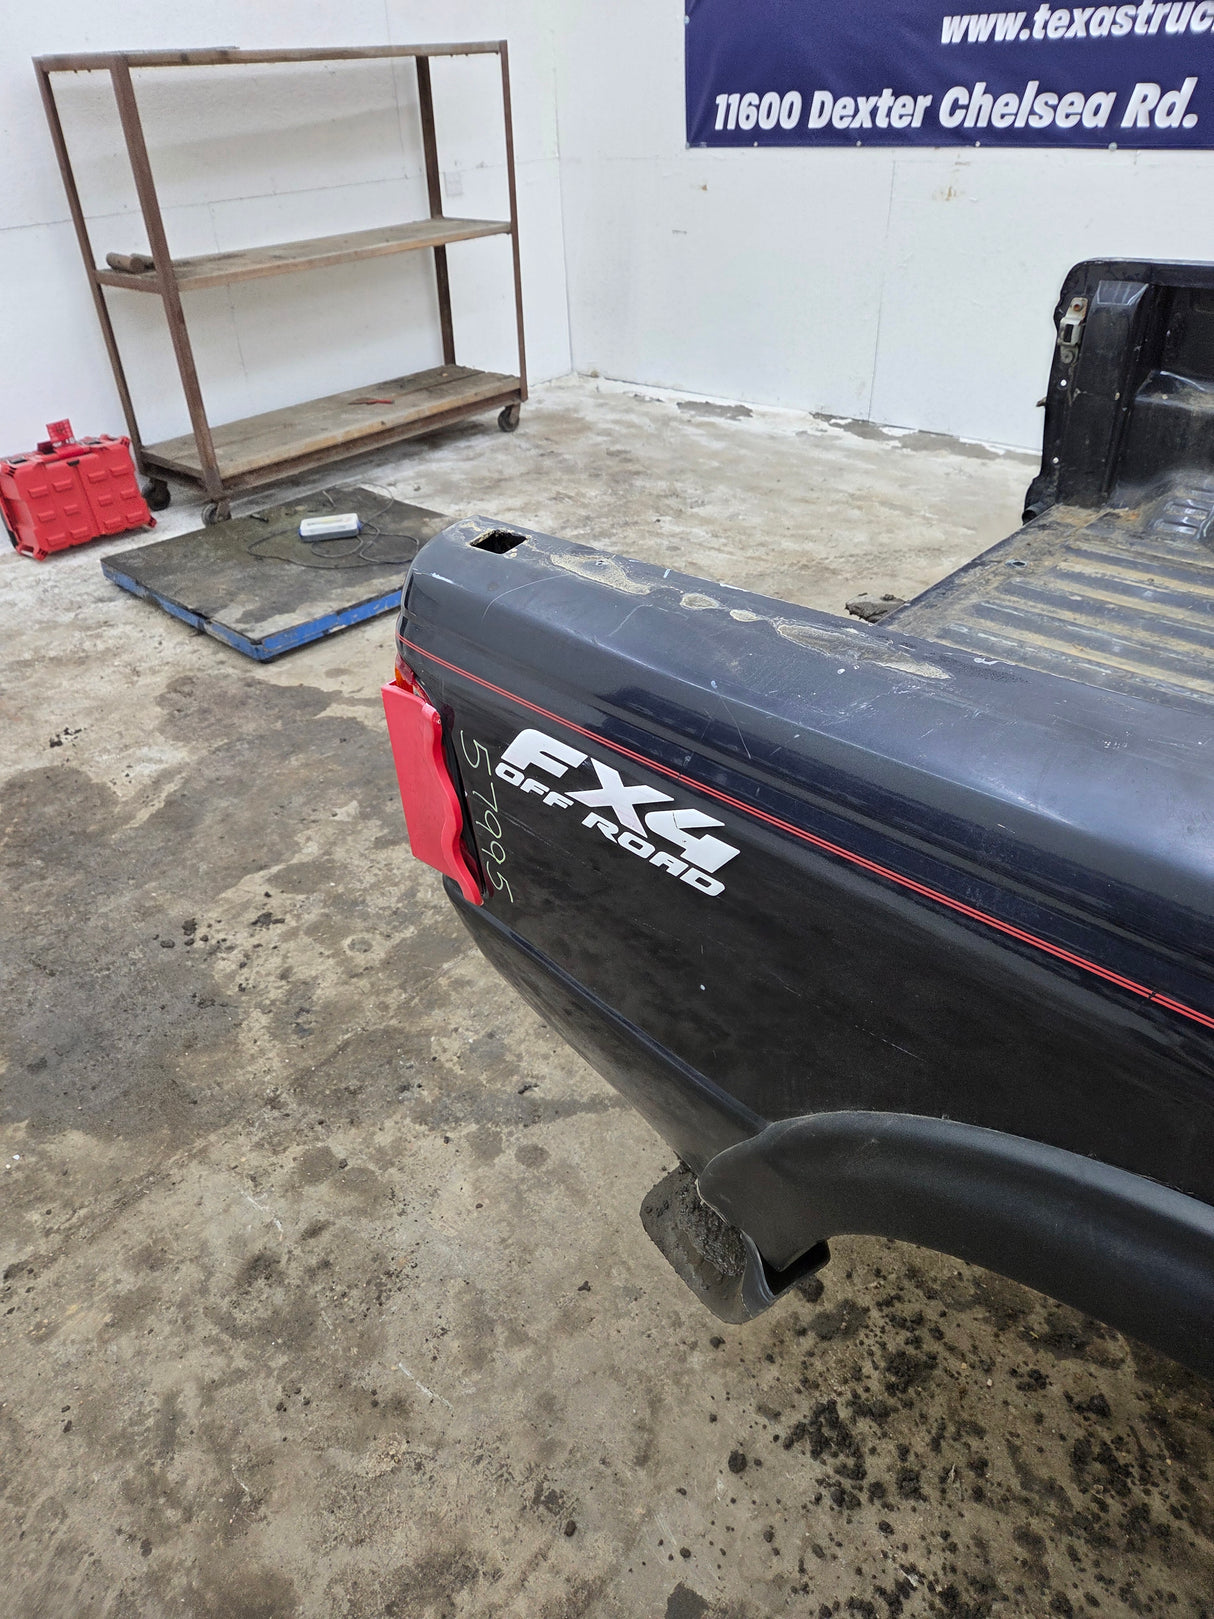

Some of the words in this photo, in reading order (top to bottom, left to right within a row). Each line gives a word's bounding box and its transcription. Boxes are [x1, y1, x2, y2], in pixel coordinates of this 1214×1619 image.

[941, 0, 1214, 44] www.texastruc
[714, 91, 802, 131] 11600
[807, 88, 932, 129] Dexter
[938, 80, 1117, 129] Chelsea
[1120, 76, 1198, 129] Rd.
[460, 730, 514, 903] 57995
[495, 762, 574, 809] OFF
[581, 811, 726, 897] ROAD
[500, 728, 741, 874] FX4
